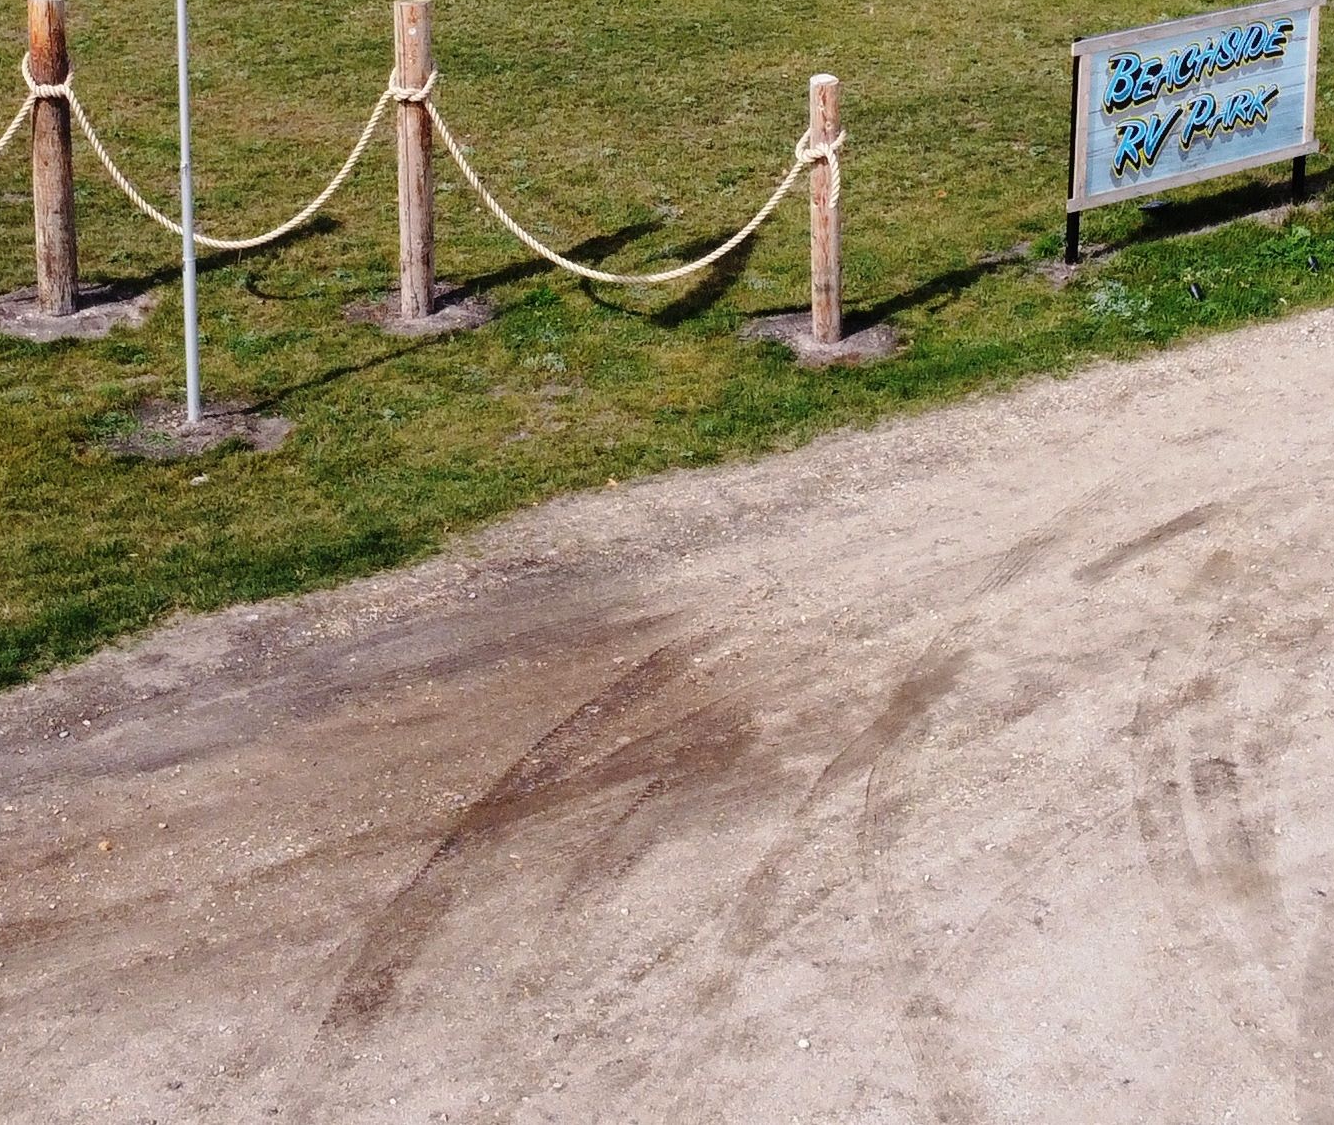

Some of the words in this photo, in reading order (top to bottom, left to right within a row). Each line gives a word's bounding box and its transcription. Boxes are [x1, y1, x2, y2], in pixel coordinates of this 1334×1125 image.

[1103, 18, 1294, 114] BEACHSIDE
[1113, 106, 1184, 178] RV
[1180, 84, 1280, 152] PARK
